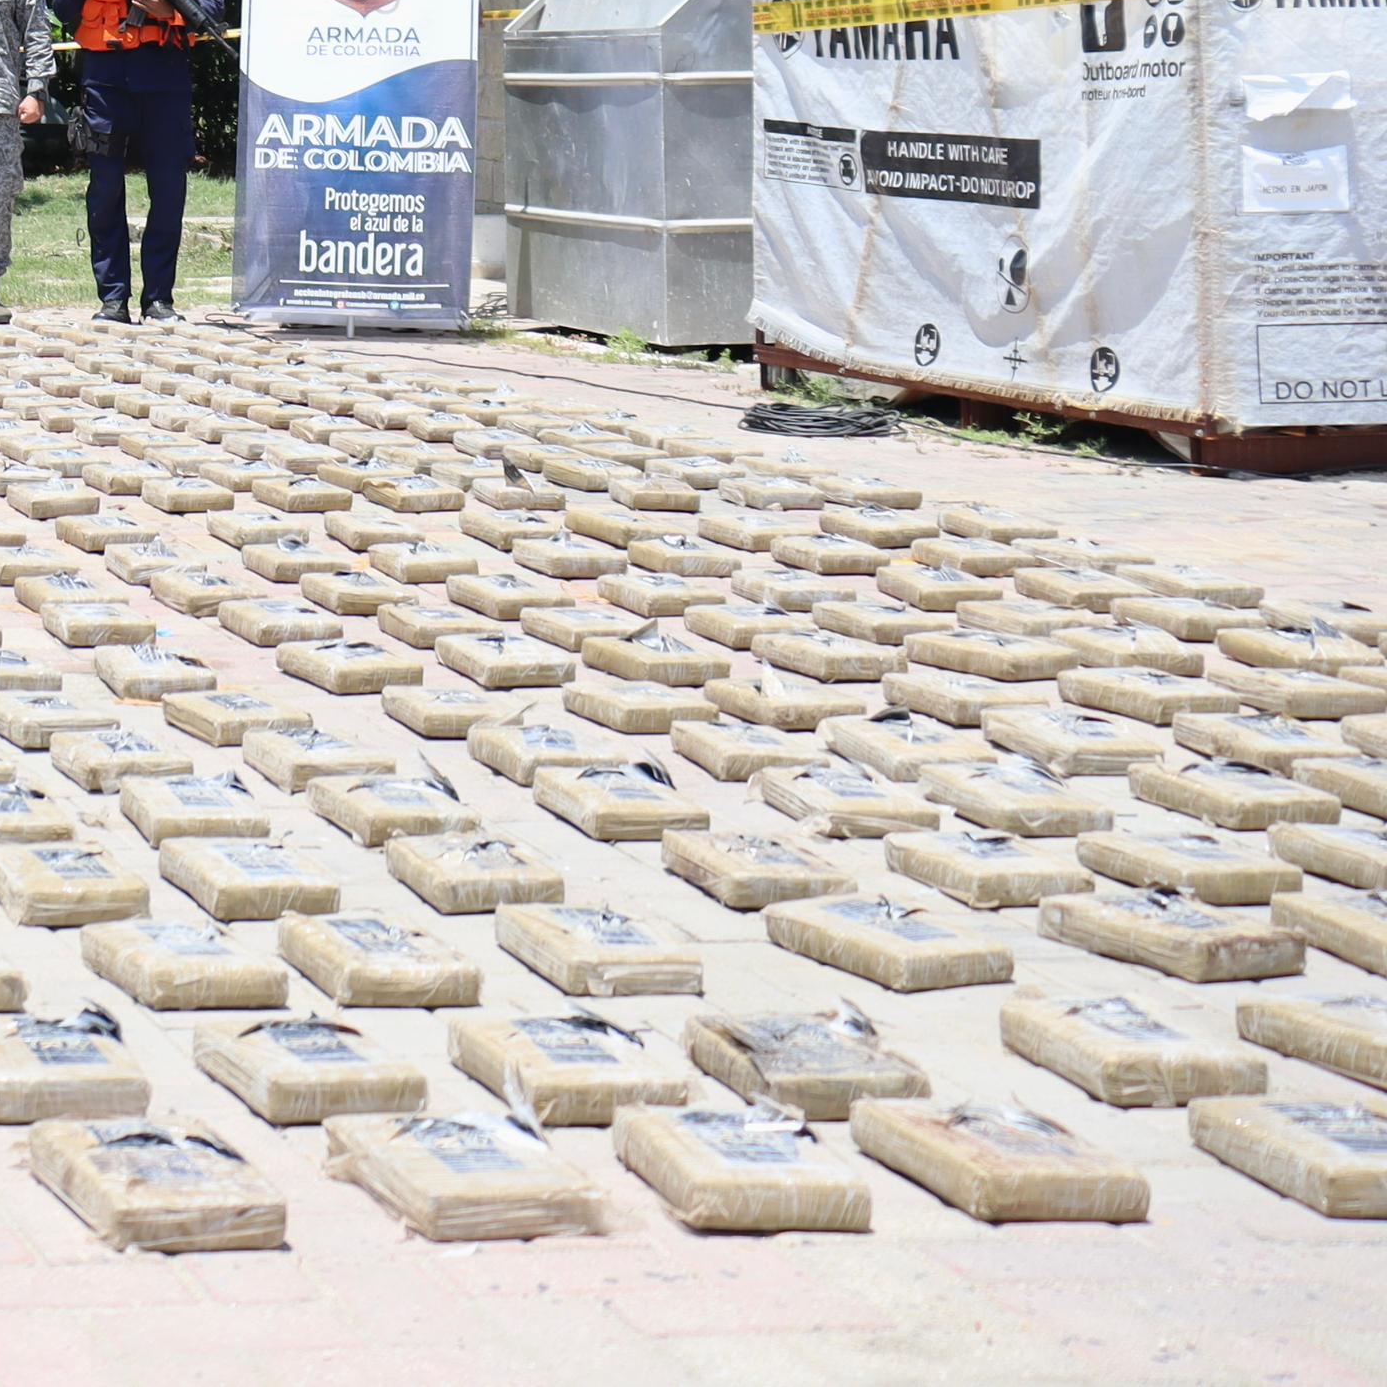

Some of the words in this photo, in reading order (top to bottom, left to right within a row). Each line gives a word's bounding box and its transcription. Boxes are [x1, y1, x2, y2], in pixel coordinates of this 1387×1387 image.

[308, 26, 421, 44] ARMADA
[306, 45, 327, 55] DE
[333, 45, 421, 57] COLOMBIA
[1140, 59, 1186, 77] motor
[255, 113, 472, 149] ARMADA
[254, 147, 299, 169] DE
[303, 148, 472, 173] COLOMBIA
[887, 141, 944, 160] HANDLE
[948, 144, 979, 162] WITH
[982, 146, 1008, 166] CARE
[867, 169, 904, 188] AVOID
[1001, 180, 1036, 199] DROP
[1262, 185, 1287, 194] HECHO
[1290, 185, 1301, 193] EN
[1305, 183, 1329, 193] JAPON
[325, 186, 425, 216] Protegemos
[350, 213, 362, 231] el
[364, 214, 390, 232] azul
[393, 215, 409, 232] de
[412, 215, 423, 232] la
[299, 229, 424, 276] bandera
[1254, 252, 1315, 261] IMPORTANT
[1276, 381, 1313, 400] DO
[1323, 380, 1371, 398] NOT
